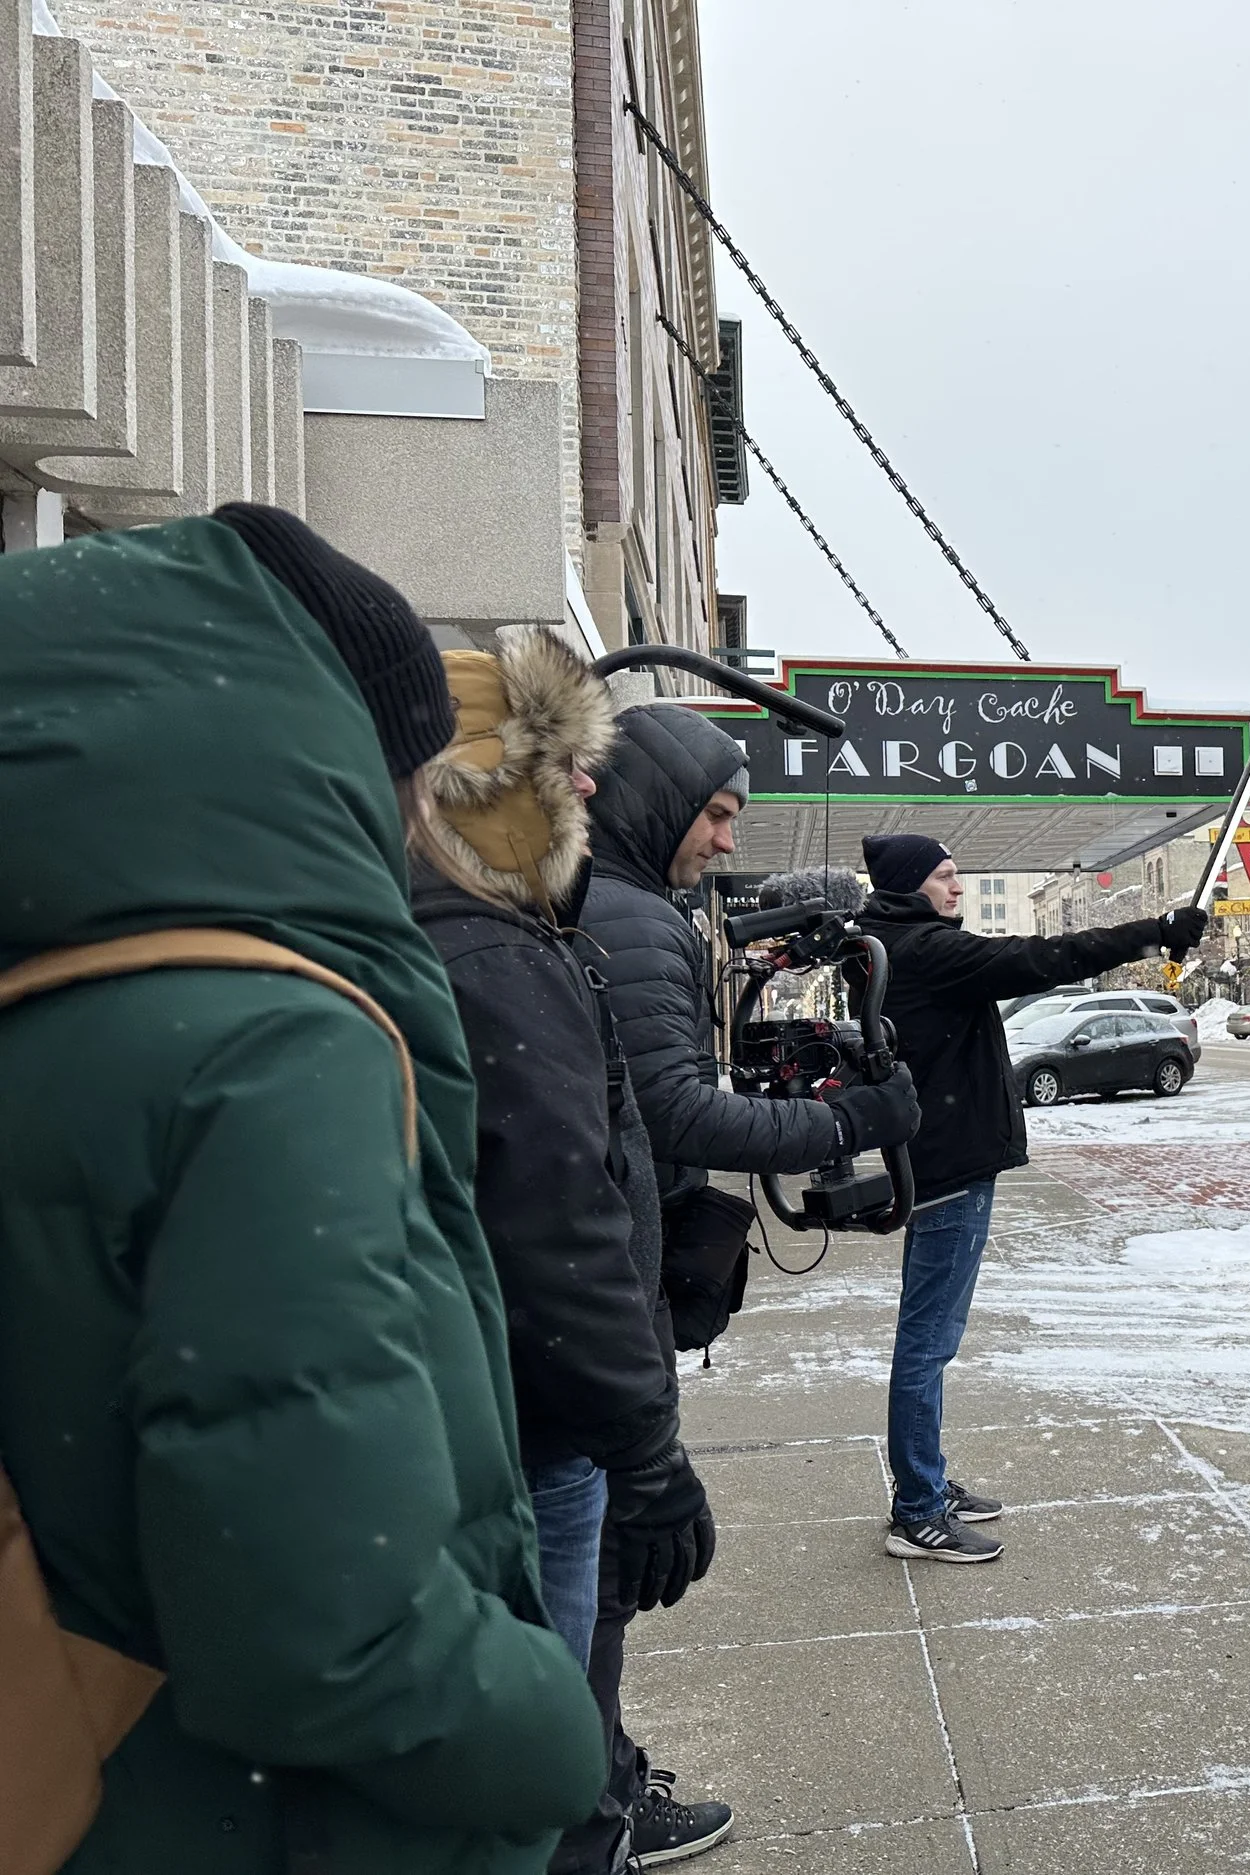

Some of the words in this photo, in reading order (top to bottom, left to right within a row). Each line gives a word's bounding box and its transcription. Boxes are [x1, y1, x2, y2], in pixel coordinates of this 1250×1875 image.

[827, 680, 956, 735] O'Day
[977, 683, 1078, 725] Cache
[783, 739, 1121, 783] FARGOAN
